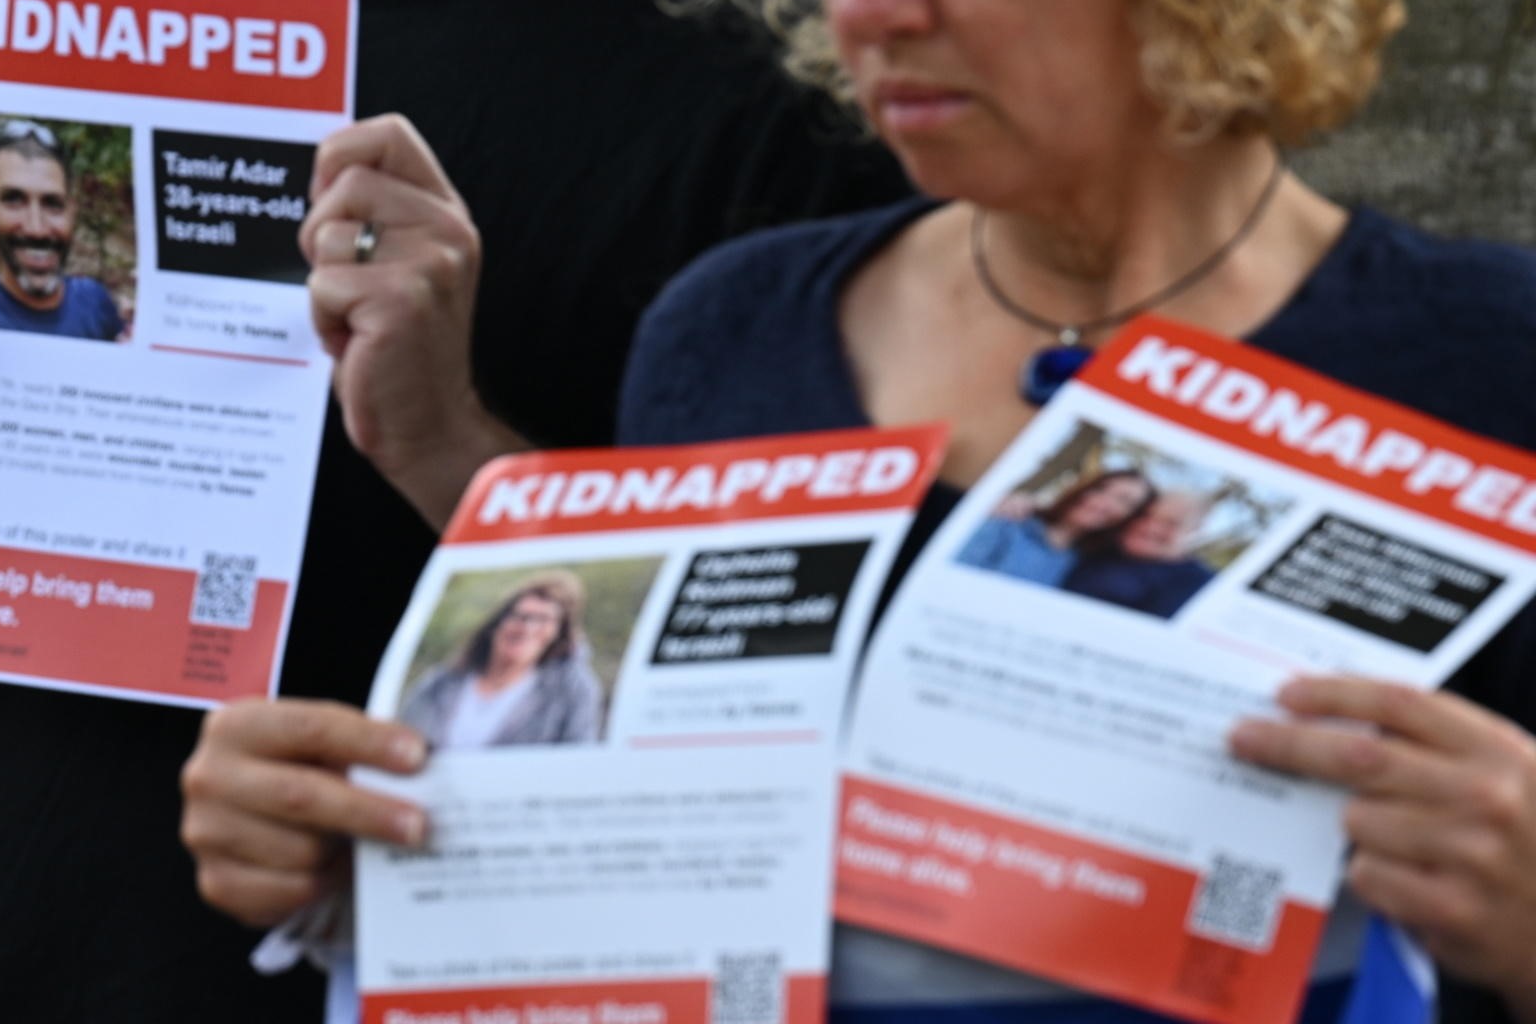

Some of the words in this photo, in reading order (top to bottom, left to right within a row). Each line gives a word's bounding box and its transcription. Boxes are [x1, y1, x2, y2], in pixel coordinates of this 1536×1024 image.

[162, 150, 228, 181] Tamir
[230, 157, 288, 186] Adar
[163, 183, 306, 221] 38-years-old
[164, 215, 237, 246] Israeli
[478, 446, 919, 524] KIDNAPPED
[32, 571, 93, 608] bring
[95, 579, 155, 610] them
